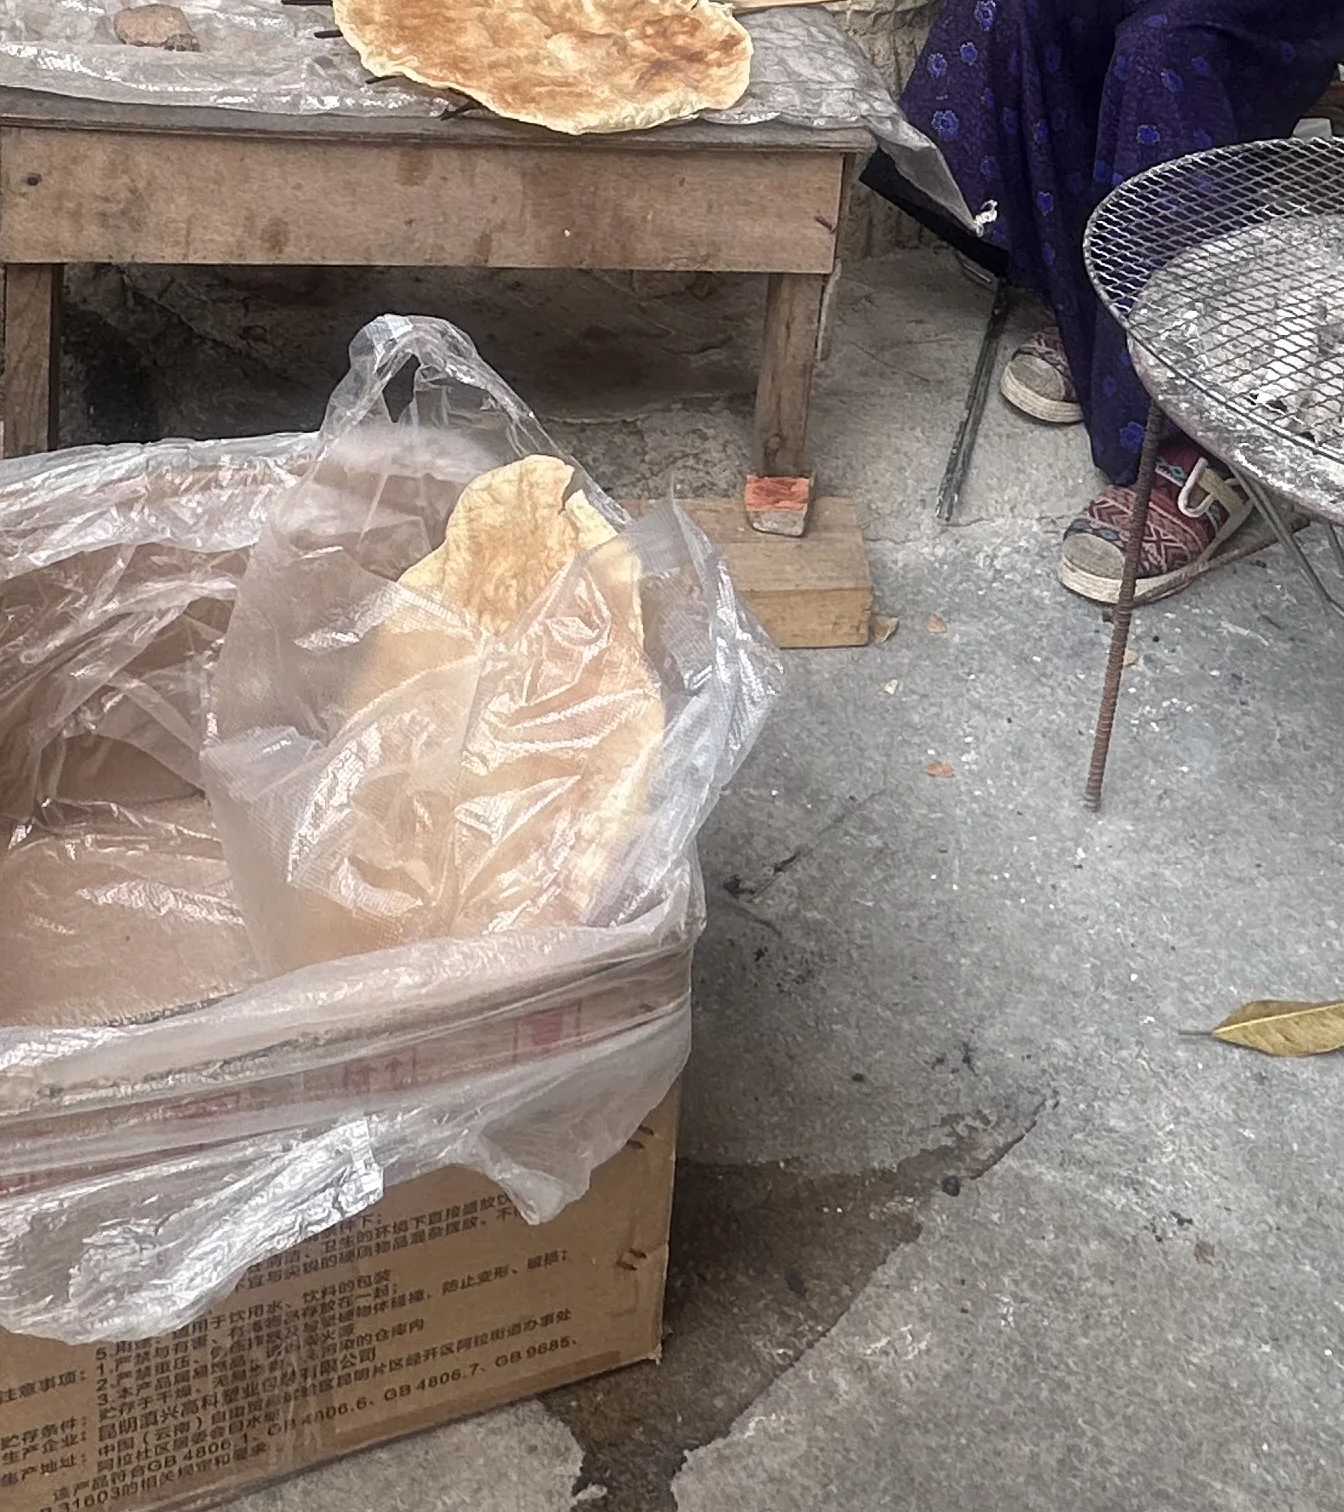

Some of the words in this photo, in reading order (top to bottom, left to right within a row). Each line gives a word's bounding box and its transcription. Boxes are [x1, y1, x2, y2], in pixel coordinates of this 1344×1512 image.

[1, 1430, 87, 1466] 生产企业：
[0, 1453, 87, 1487] 生产地址：
